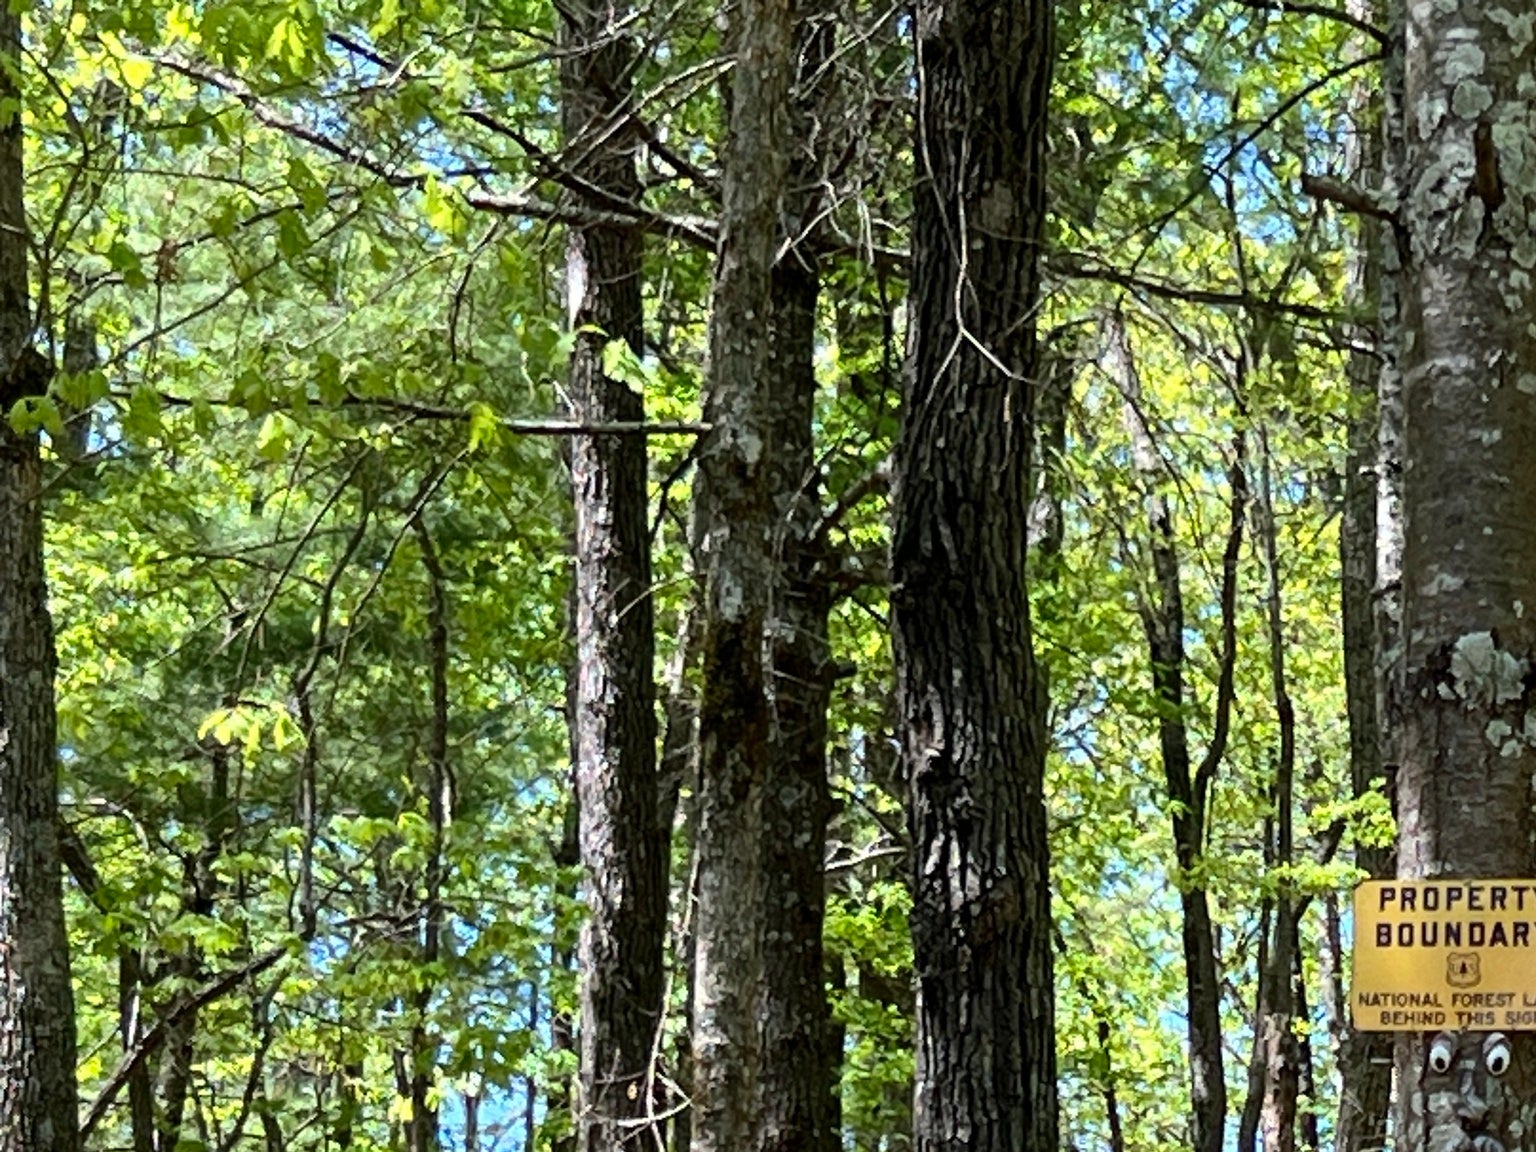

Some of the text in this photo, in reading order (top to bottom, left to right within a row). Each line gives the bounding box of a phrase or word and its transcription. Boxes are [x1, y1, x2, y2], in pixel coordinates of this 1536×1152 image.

[1358, 991, 1443, 1008] NATIONAL
[1451, 991, 1516, 1008] FOREST
[1379, 1010, 1446, 1026] BEHIND
[1454, 1010, 1496, 1026] THIS
